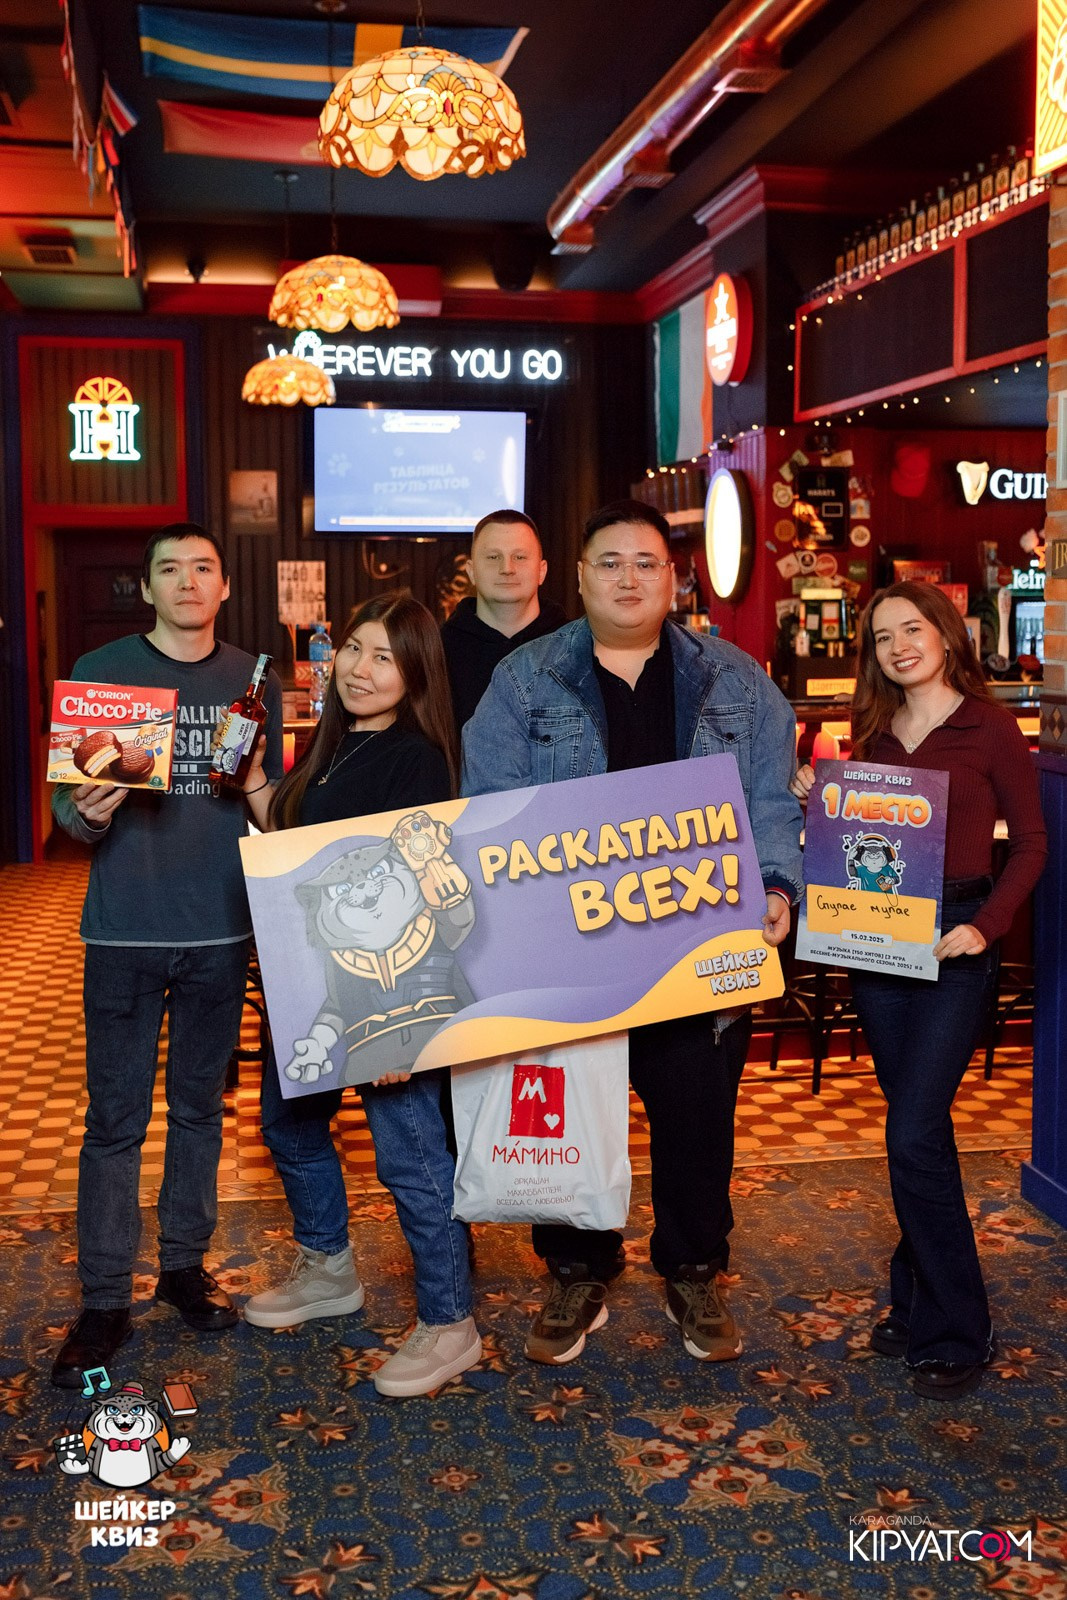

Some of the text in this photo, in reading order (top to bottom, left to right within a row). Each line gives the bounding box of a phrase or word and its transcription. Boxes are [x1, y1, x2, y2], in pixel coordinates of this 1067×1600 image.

[451, 349, 510, 380] YOU
[522, 349, 563, 380] GO
[390, 464, 454, 478] ТАБЛИЦА
[374, 477, 470, 494] РЕЗУЛЬТАТОВ
[98, 691, 131, 700] ORION
[843, 770, 912, 786] ШЕЙКЕР КВИЗ
[823, 783, 931, 826] 1 МЕСТО
[478, 802, 739, 885] РАСКАТАЛИ
[568, 853, 740, 933] ВСЕХ!
[827, 945, 851, 954] МУЗЫКА
[694, 947, 767, 978] ШЕЙКЕР
[876, 959, 896, 968] СЕЗОНА
[710, 969, 760, 995] КВИЗ
